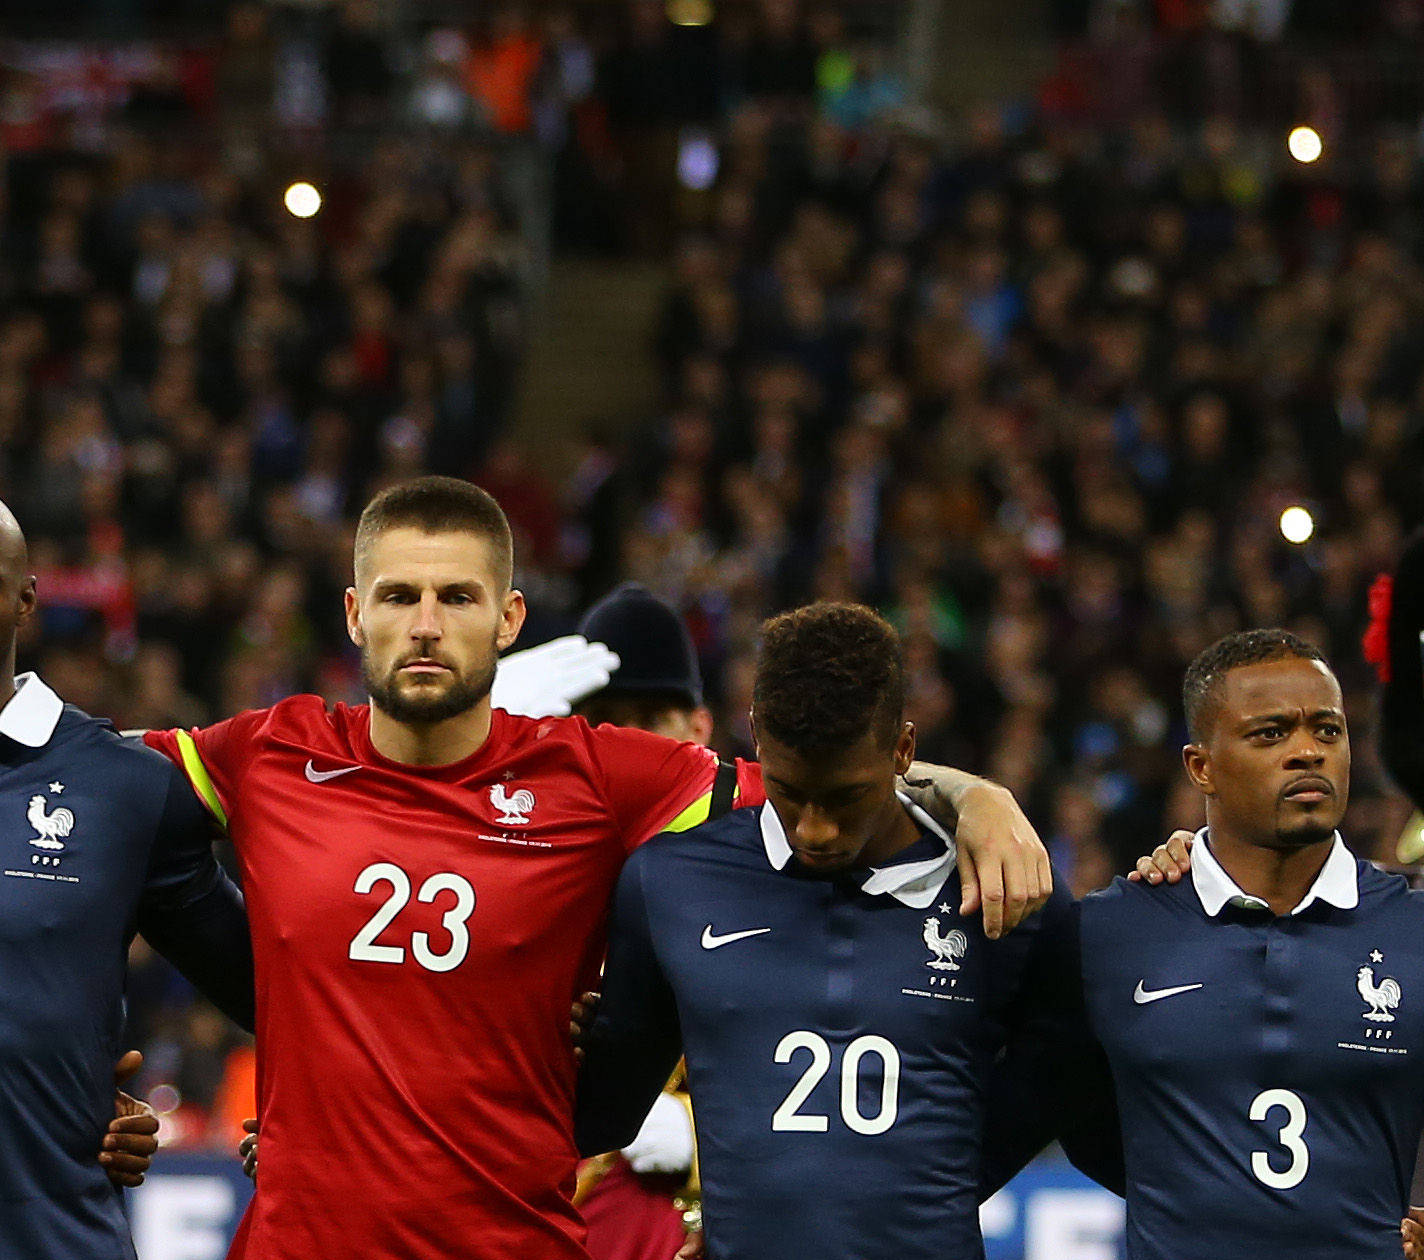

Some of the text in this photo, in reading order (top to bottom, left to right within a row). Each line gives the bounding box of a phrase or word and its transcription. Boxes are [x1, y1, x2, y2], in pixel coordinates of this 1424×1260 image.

[348, 862, 476, 973] 23
[772, 1029, 901, 1135] 20
[1248, 1088, 1310, 1190] 3
